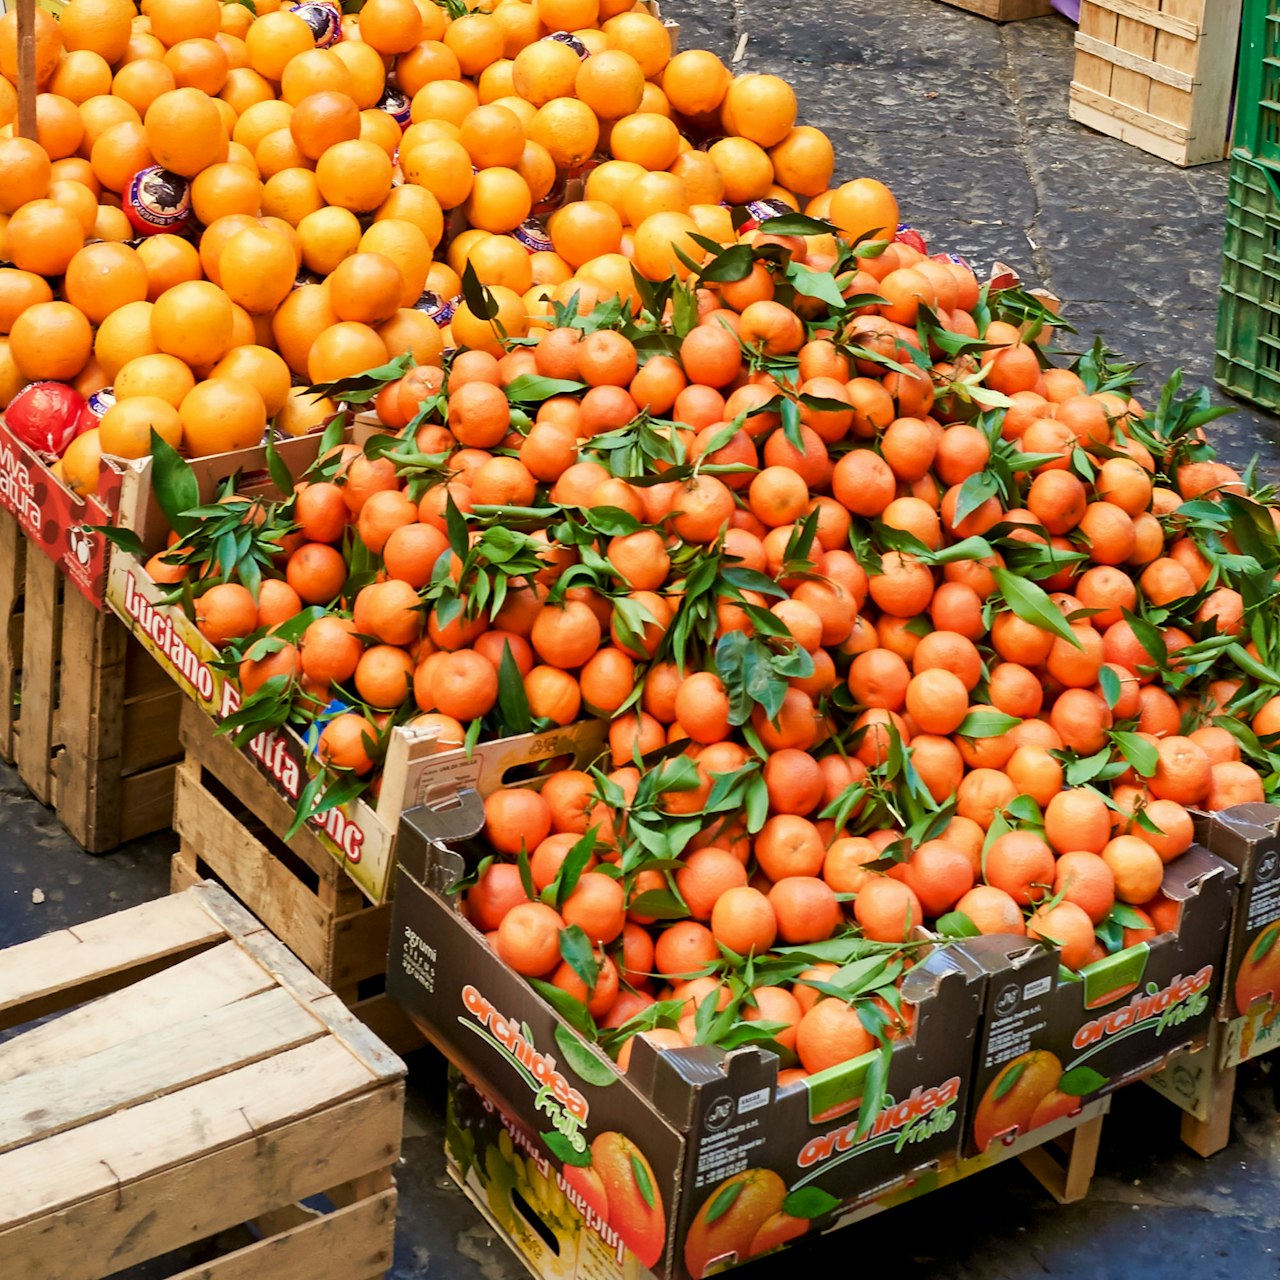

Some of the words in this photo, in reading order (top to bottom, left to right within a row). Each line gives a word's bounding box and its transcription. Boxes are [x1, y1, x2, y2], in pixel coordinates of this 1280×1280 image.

[124, 570, 214, 700] Luciano
[404, 926, 437, 963] agrumi
[1072, 964, 1214, 1050] orchidea
[462, 984, 590, 1126] orchidea
[556, 1172, 626, 1266] Luciano
